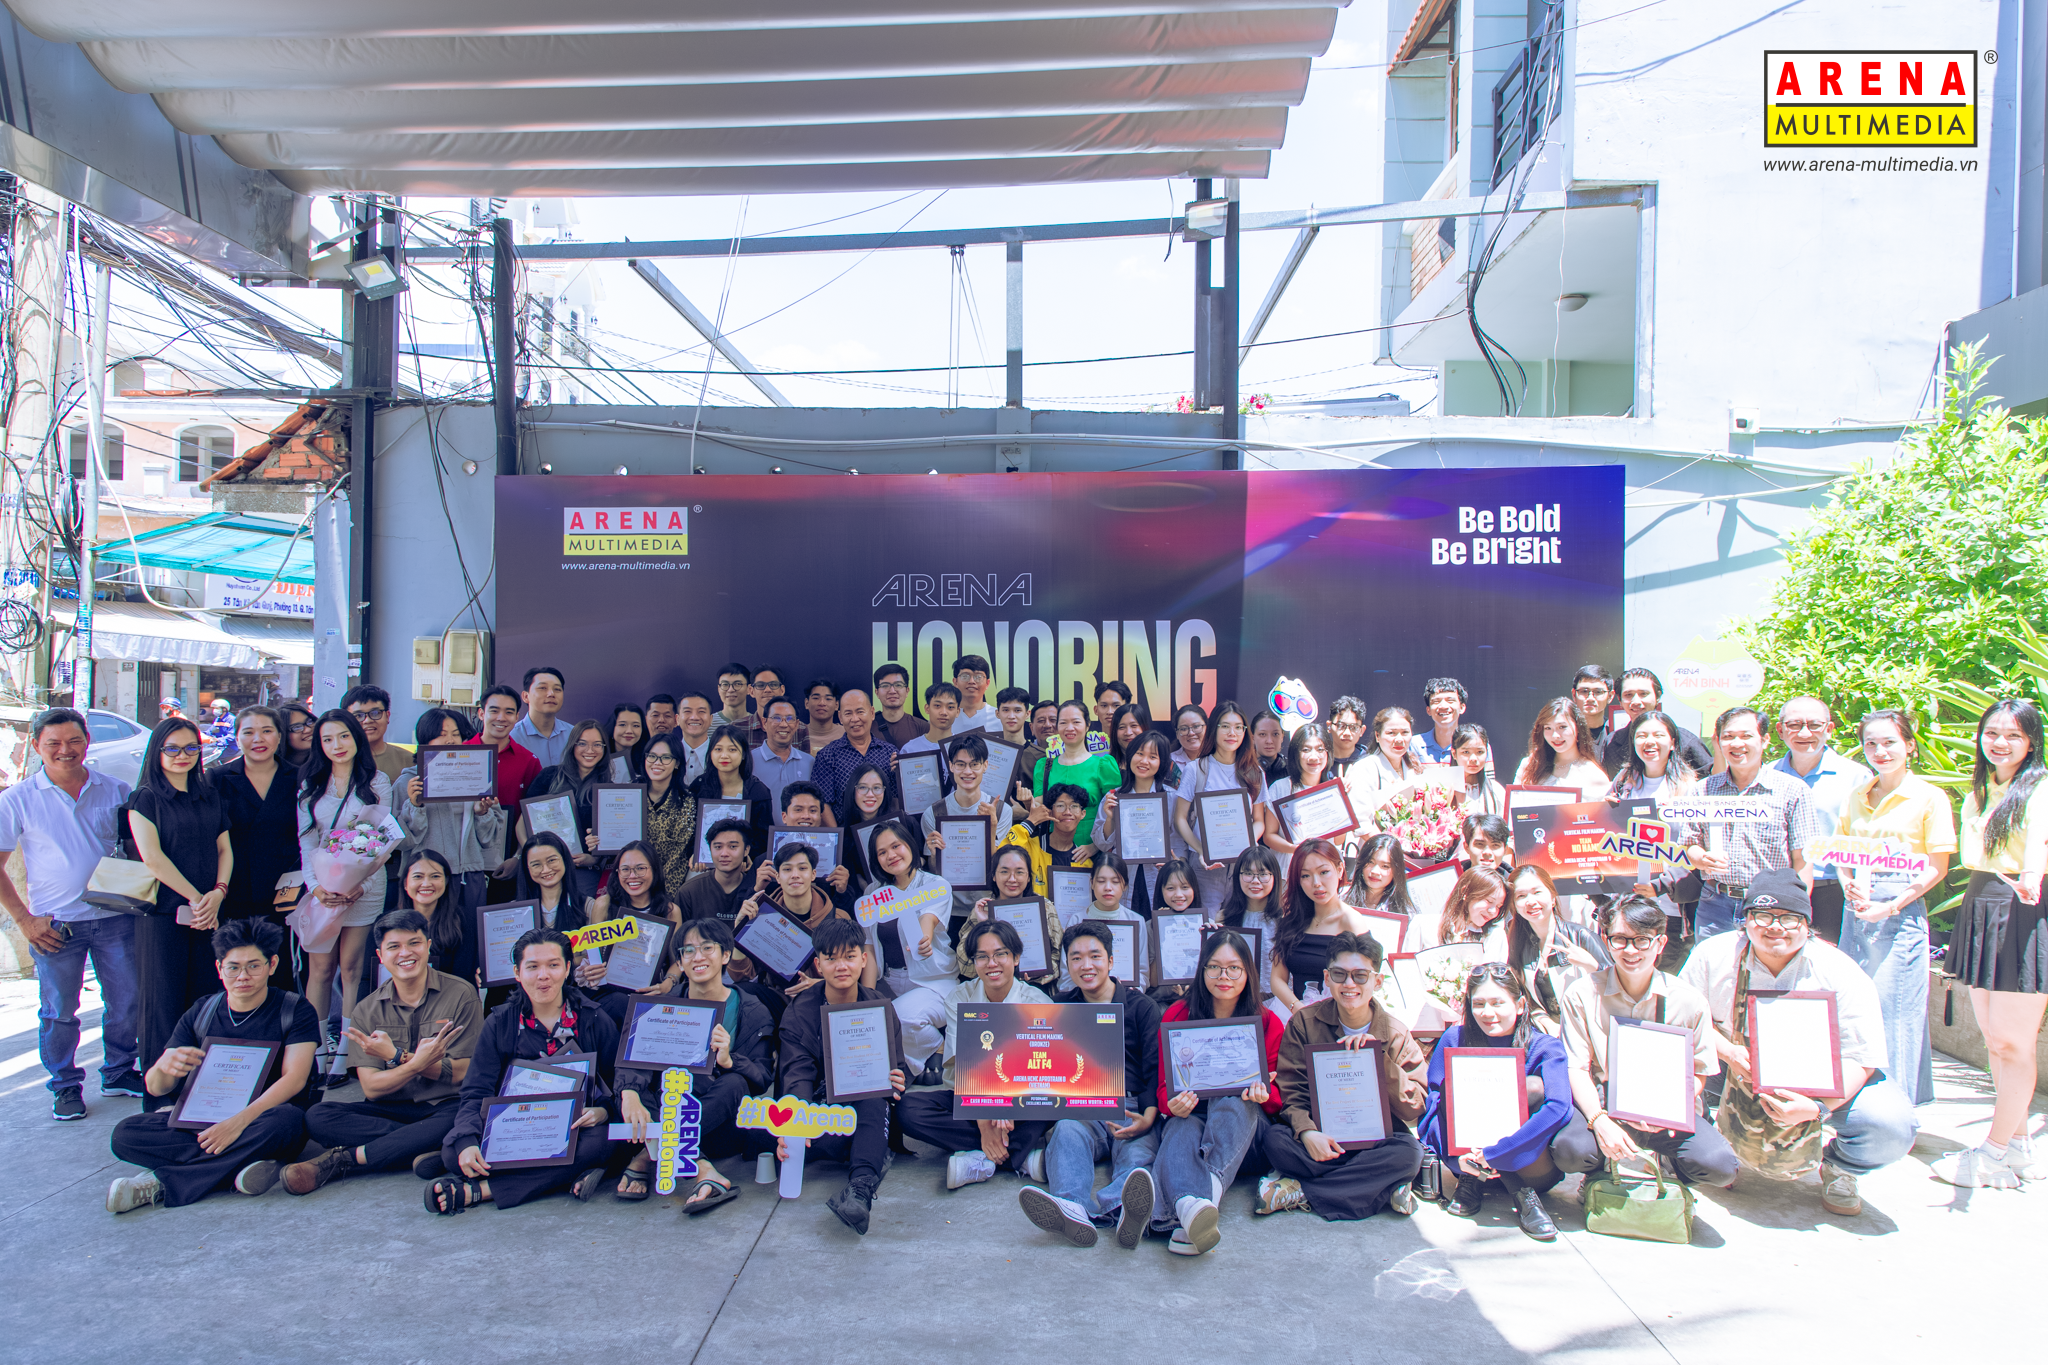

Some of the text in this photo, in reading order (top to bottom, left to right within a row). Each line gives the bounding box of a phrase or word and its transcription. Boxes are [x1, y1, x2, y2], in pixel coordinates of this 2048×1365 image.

[570, 511, 683, 530] ARENA
[1459, 503, 1560, 533] Be Bold
[568, 539, 683, 551] MULTIMEDIA
[1432, 537, 1561, 565] Be Bright
[561, 561, 691, 571] www.arena-multimedia.vn
[872, 573, 1032, 607] ARENA
[872, 619, 1217, 722] HONORING
[1663, 809, 1768, 820] CHỌN ARENA
[1582, 843, 1600, 852] NAM
[1603, 836, 1691, 866] ARENA
[1822, 851, 1925, 871] MULTIMEDIA
[579, 921, 634, 946] ARENA
[839, 1026, 875, 1035] CERTIFICATE
[1028, 1059, 1052, 1069] ALT F4
[793, 1108, 854, 1128] Arena
[678, 1094, 700, 1174] ARENA
